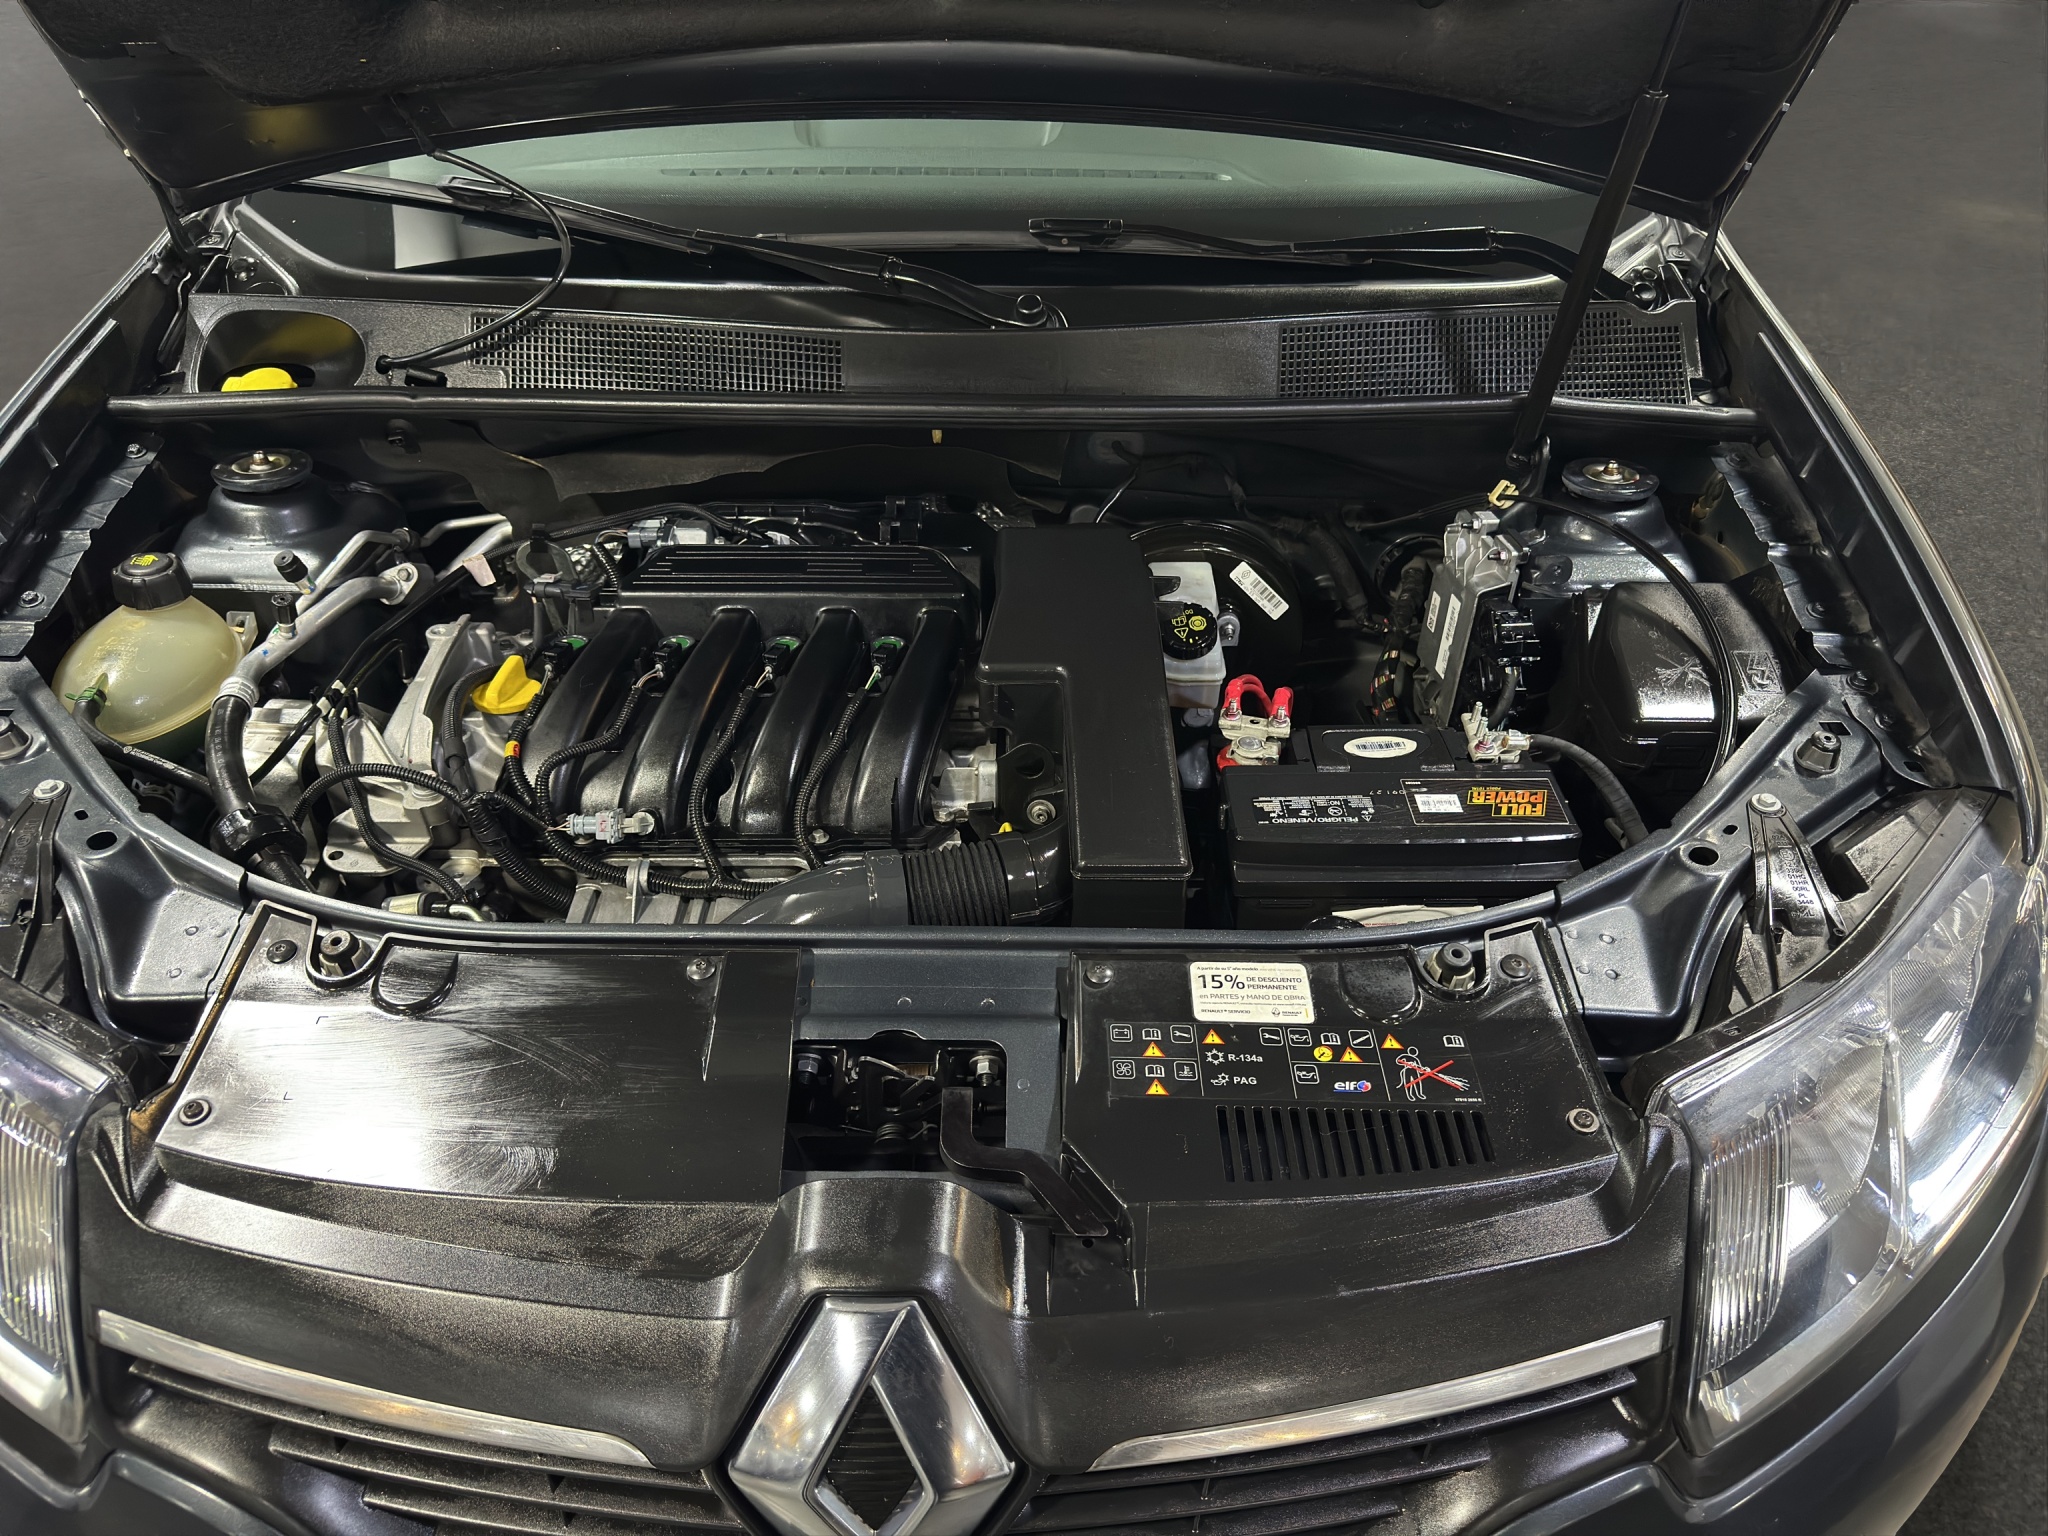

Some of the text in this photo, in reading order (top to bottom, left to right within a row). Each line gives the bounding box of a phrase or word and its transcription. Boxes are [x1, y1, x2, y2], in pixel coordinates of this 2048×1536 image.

[1471, 790, 1544, 803] POWER
[1496, 803, 1542, 815] FULL
[1272, 816, 1359, 825] PELIGRO/VENENO
[1197, 974, 1246, 990] 15%
[1257, 976, 1303, 984] DESCUENTO
[1227, 1053, 1264, 1063] R-134a
[1233, 1076, 1258, 1086] PAG
[1333, 1080, 1359, 1092] elf
